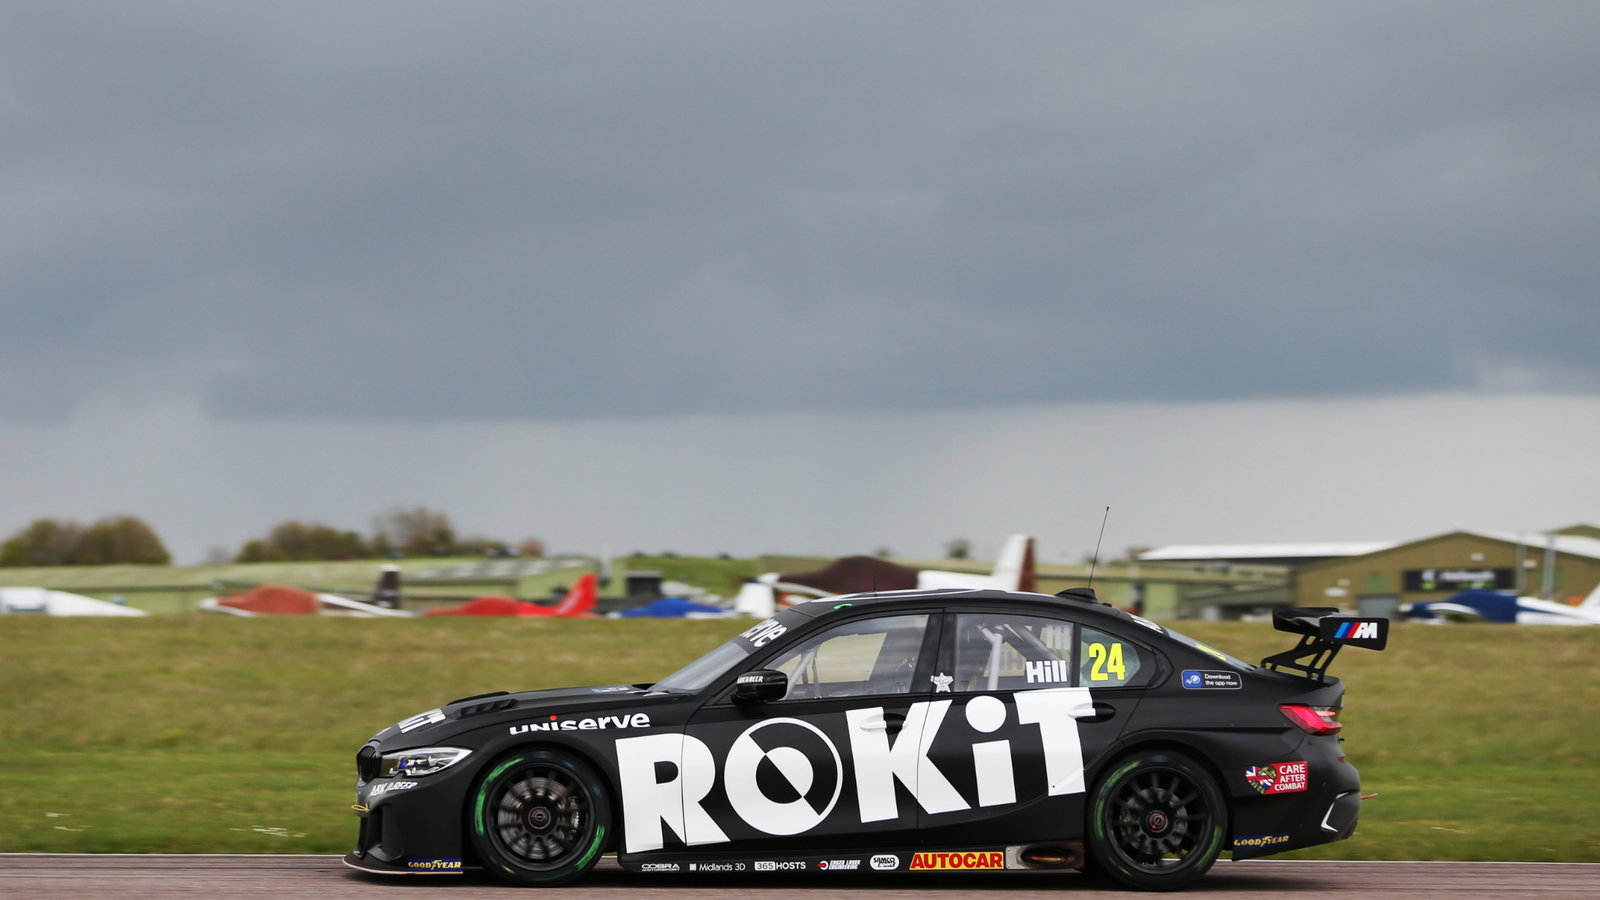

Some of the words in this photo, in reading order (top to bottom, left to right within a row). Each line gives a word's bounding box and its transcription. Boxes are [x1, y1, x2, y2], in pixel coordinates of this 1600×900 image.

[1089, 643, 1126, 681] 24
[1025, 659, 1068, 684] Hill
[1279, 763, 1306, 775] CARE
[1279, 773, 1306, 784] AFTER
[1274, 782, 1306, 792] COMBAT
[873, 856, 896, 864] SAMCO
[910, 852, 1004, 869] AUTOCAR
[698, 862, 733, 872] Midlands
[734, 862, 746, 871] 3D
